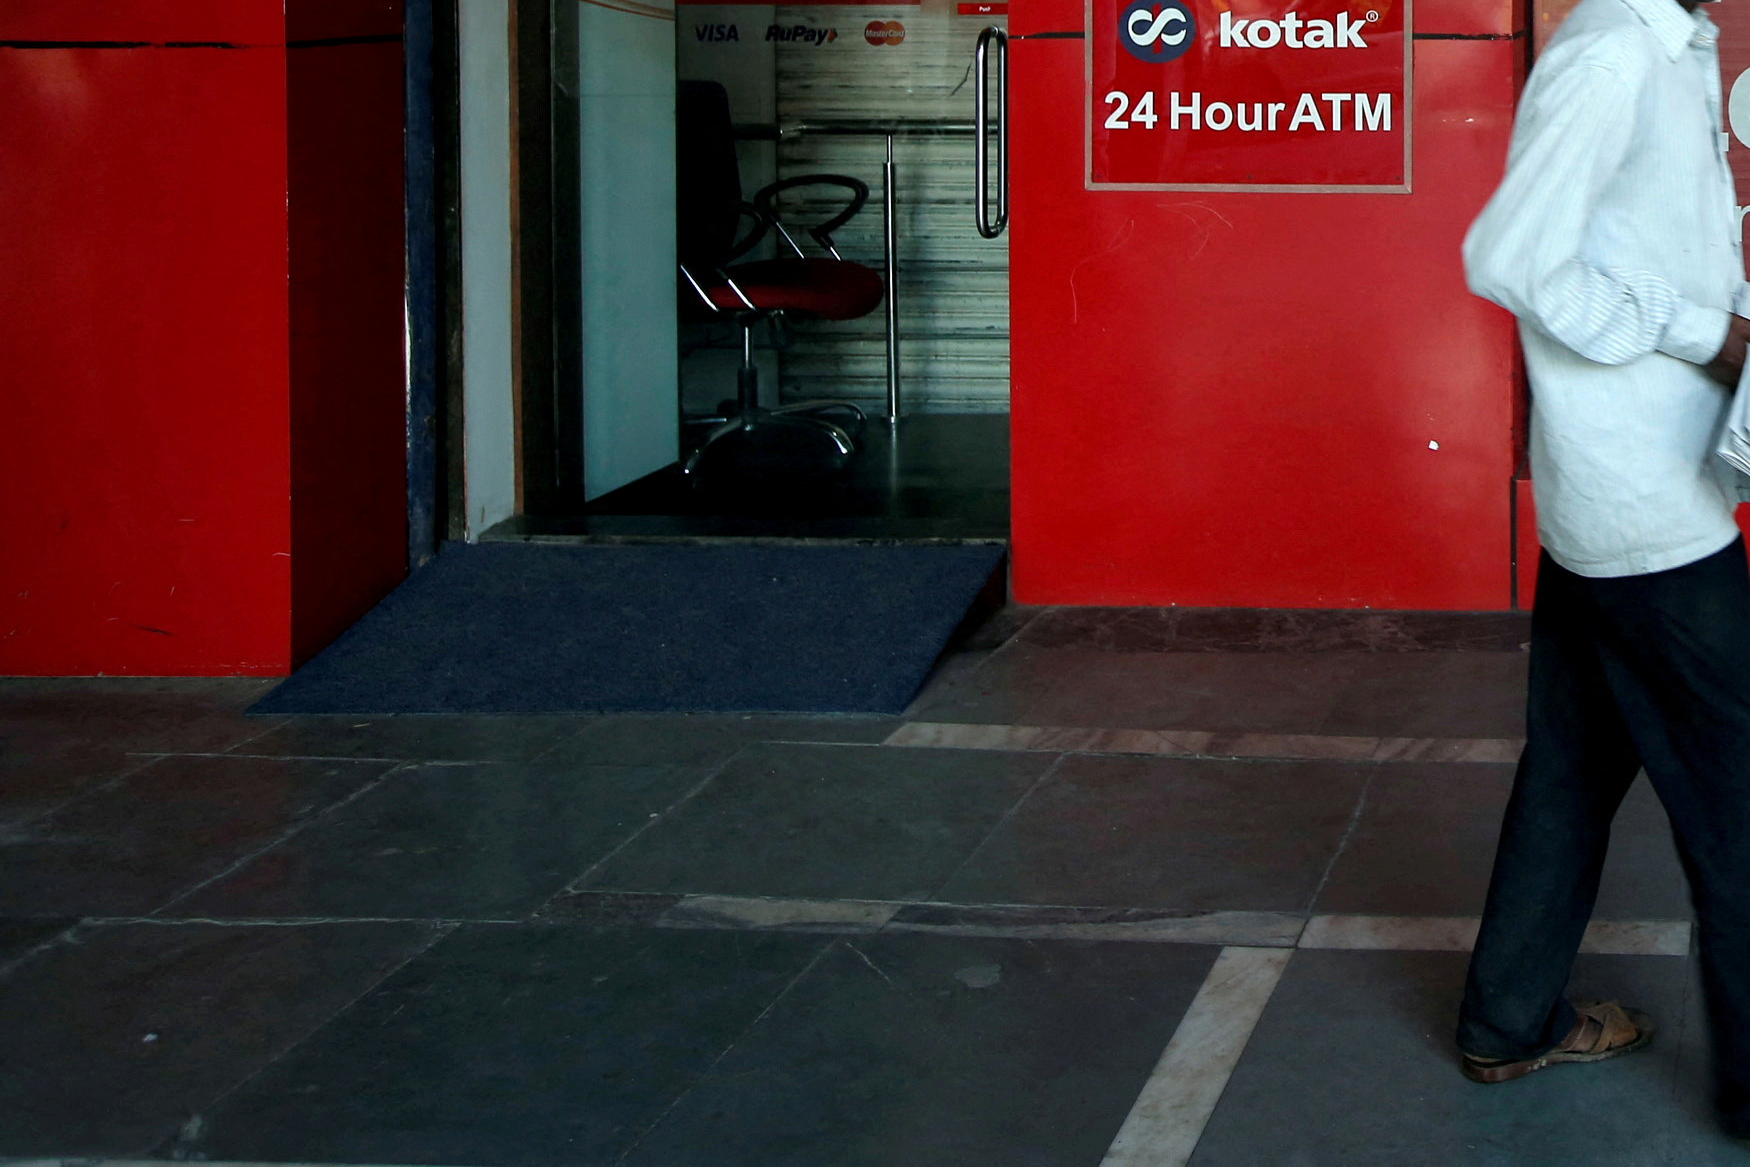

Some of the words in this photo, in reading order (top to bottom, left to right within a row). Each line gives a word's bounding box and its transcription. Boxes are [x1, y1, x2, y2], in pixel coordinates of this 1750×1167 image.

[694, 23, 740, 42] VISA
[765, 25, 829, 46] RuPay
[865, 29, 906, 38] MasterCard
[1104, 90, 1158, 130] 24
[1170, 91, 1286, 131] Hour
[1288, 92, 1392, 132] ATM
